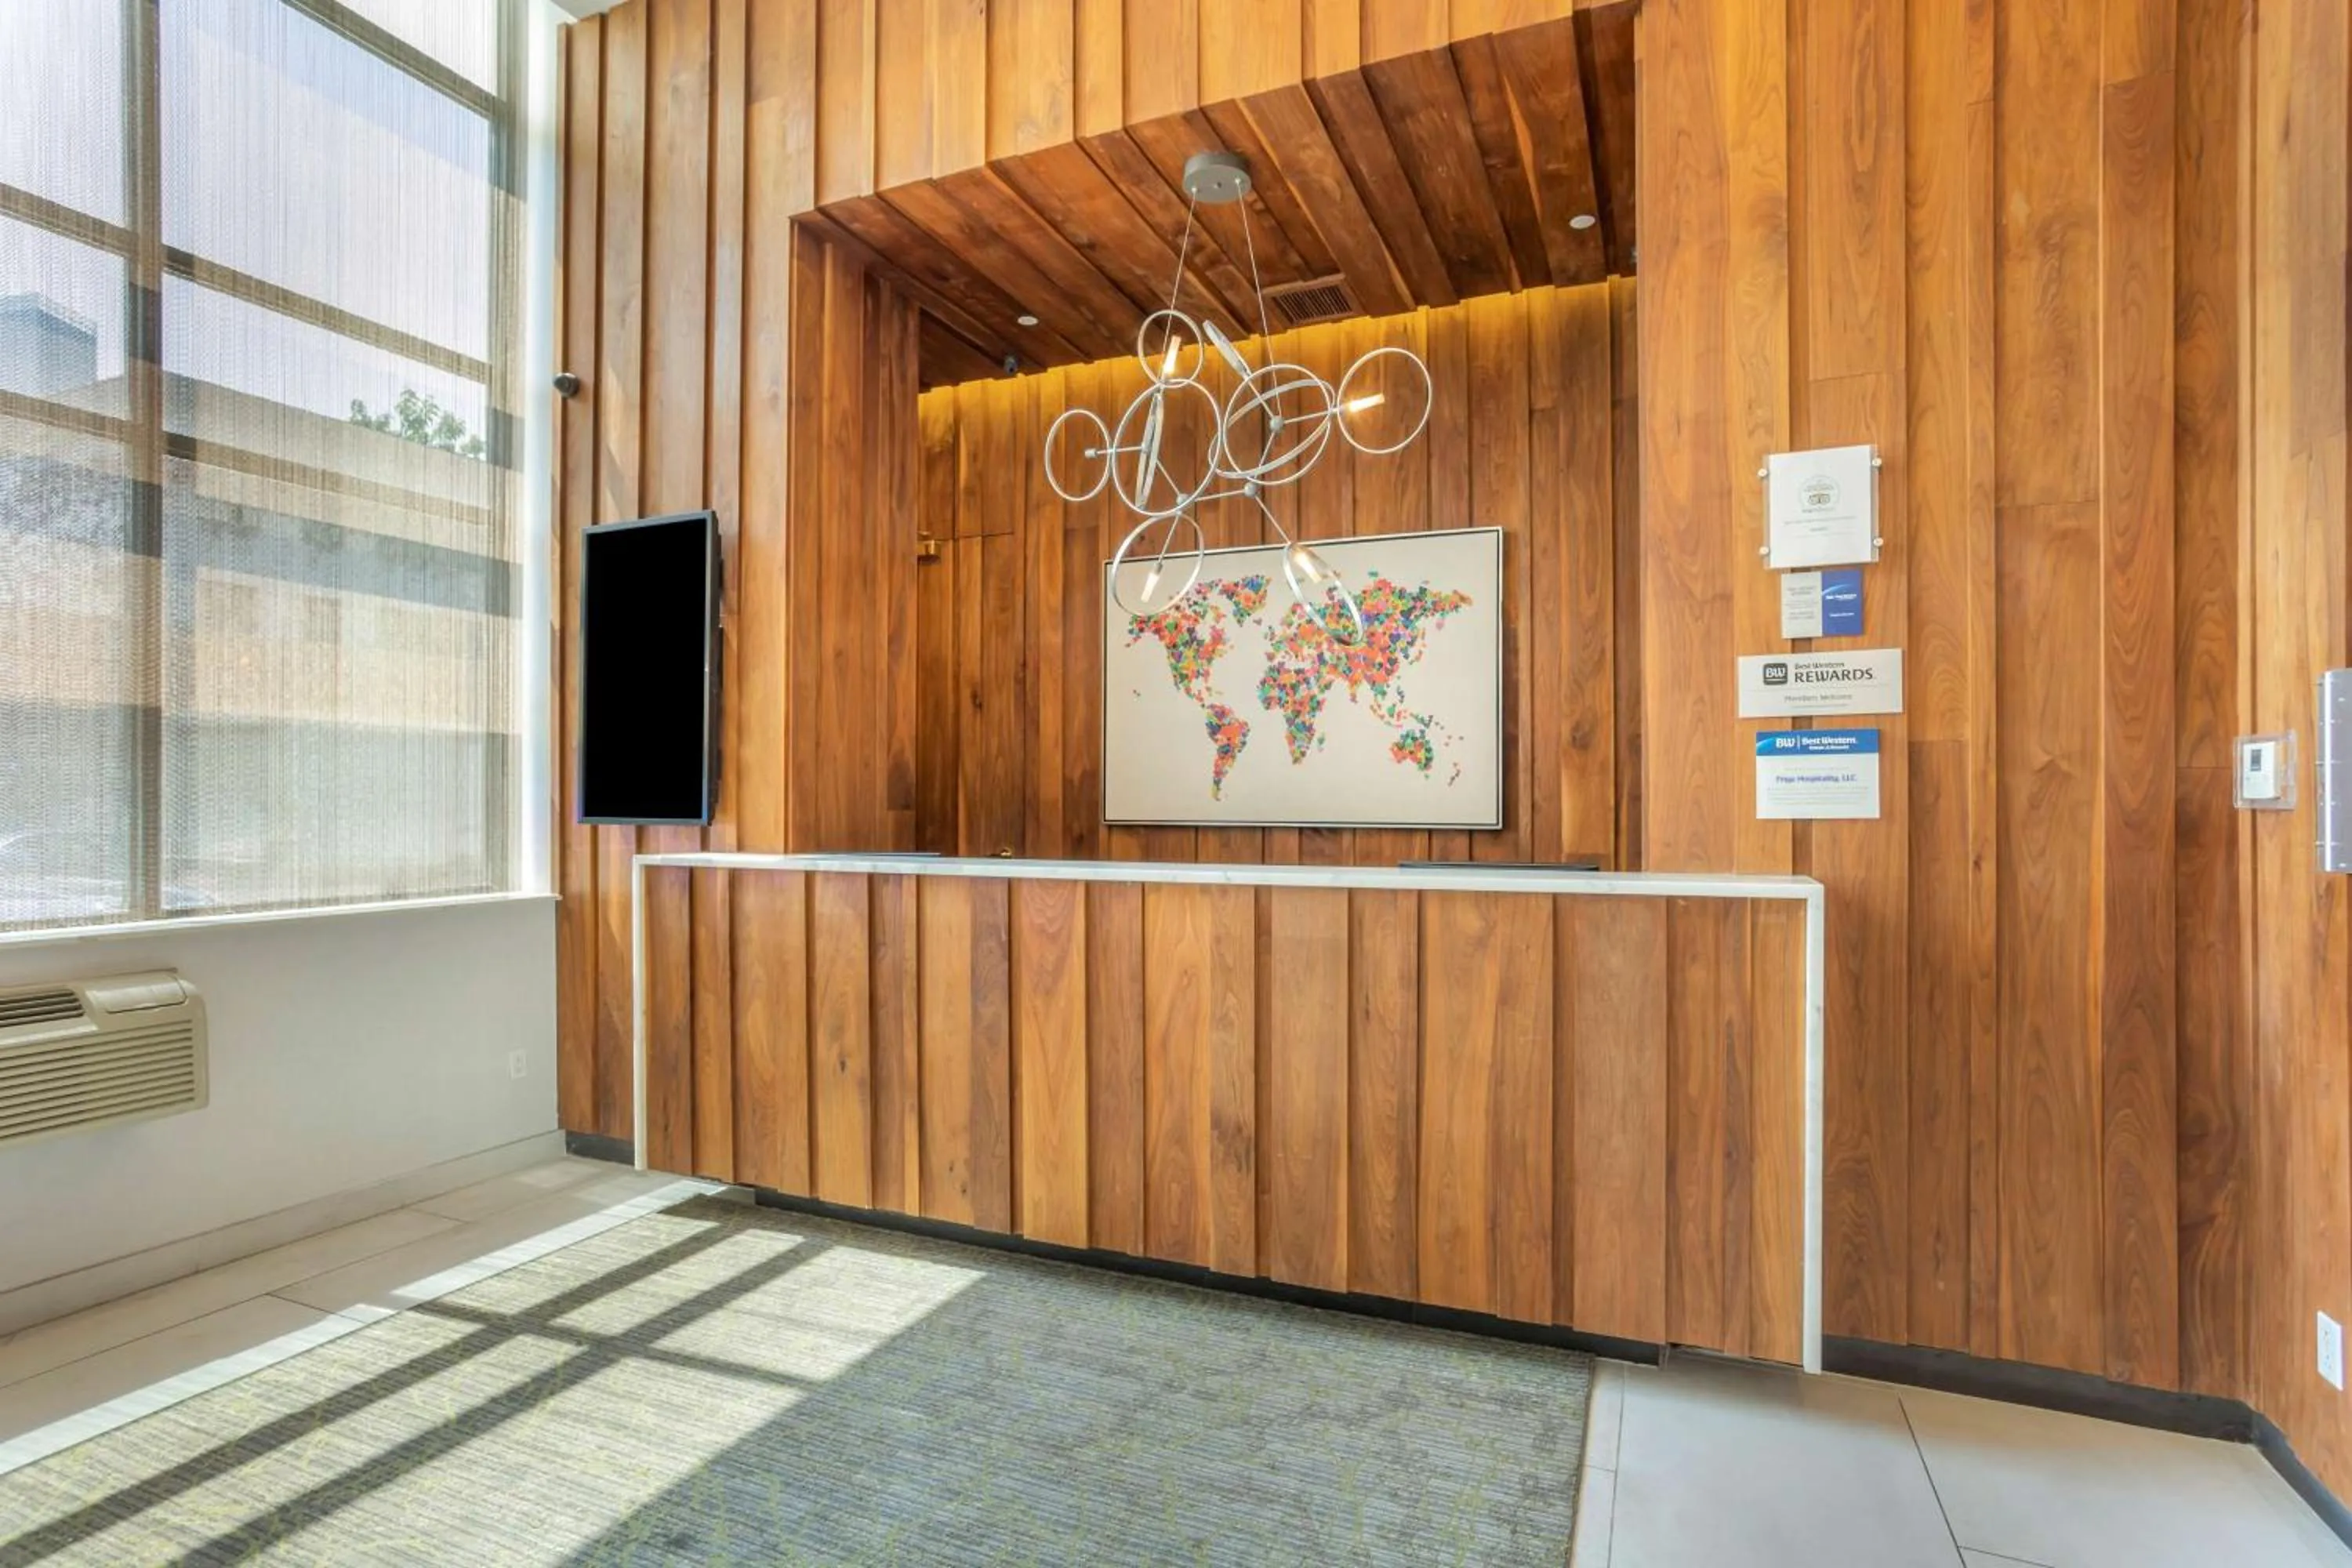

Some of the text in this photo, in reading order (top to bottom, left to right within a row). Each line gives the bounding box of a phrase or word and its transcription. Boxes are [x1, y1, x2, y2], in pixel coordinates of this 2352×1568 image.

[1766, 666, 1786, 678] BW
[1795, 668, 1873, 683] REWARDS
[1776, 738, 1795, 748] BW
